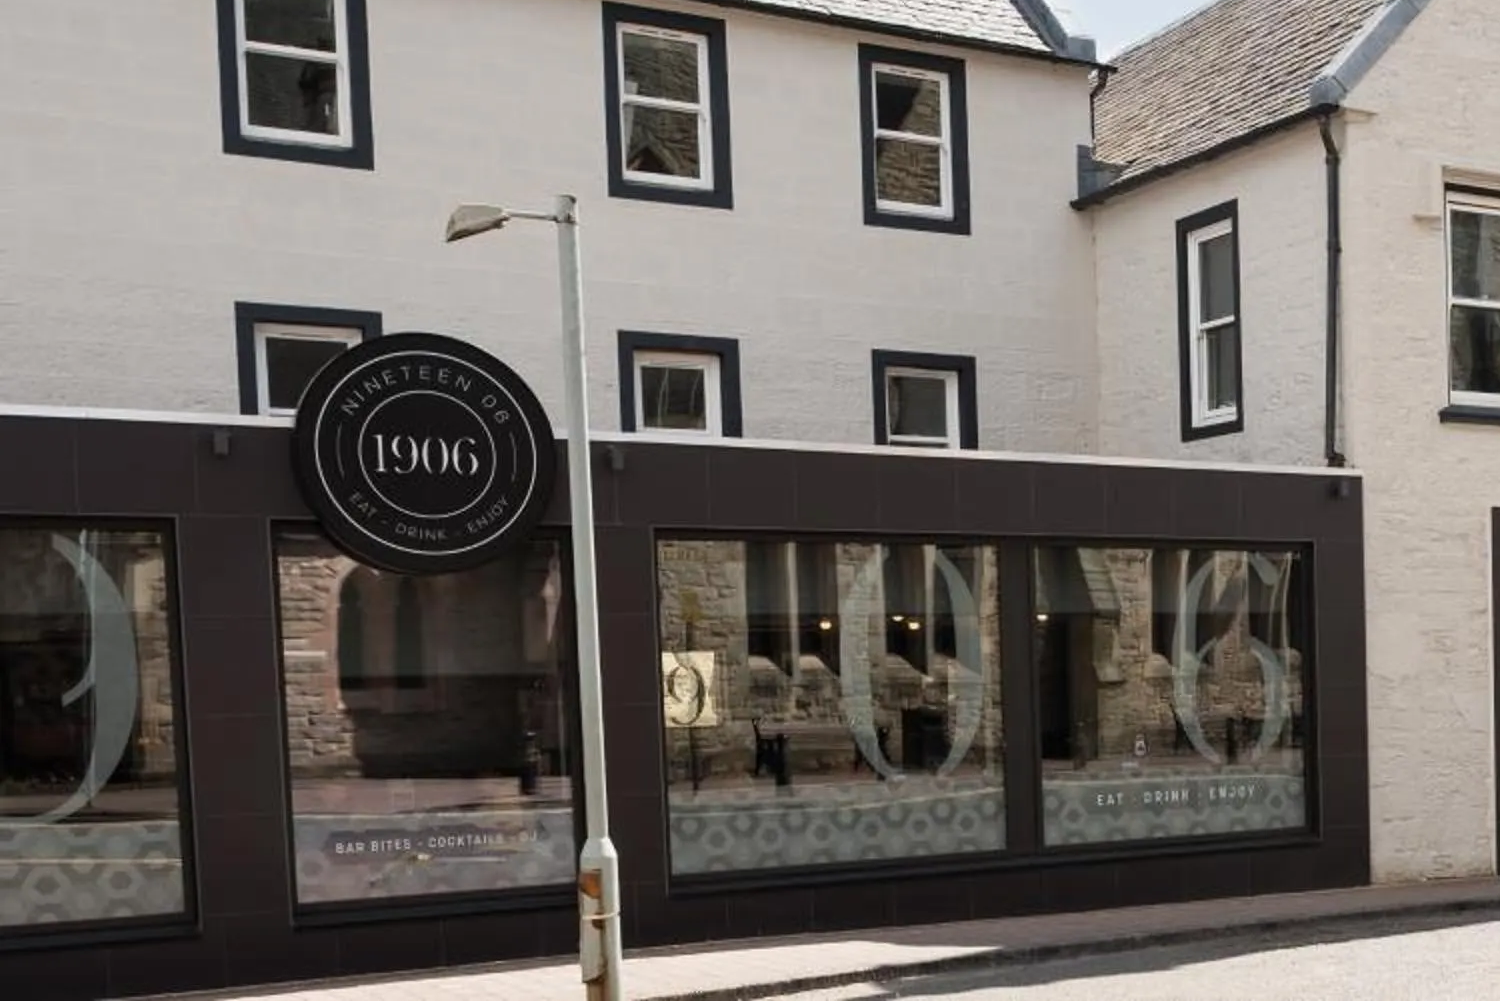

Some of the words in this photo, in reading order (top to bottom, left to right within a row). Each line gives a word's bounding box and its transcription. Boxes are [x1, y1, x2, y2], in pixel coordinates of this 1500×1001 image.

[342, 365, 472, 416] NINETEEN
[373, 433, 480, 477] 1906
[349, 492, 378, 518] EAT
[395, 523, 450, 542] DRINK
[467, 494, 509, 534] ENJOY
[1097, 793, 1124, 806] EAT
[335, 841, 365, 854] BAR
[371, 838, 412, 852] BITES
